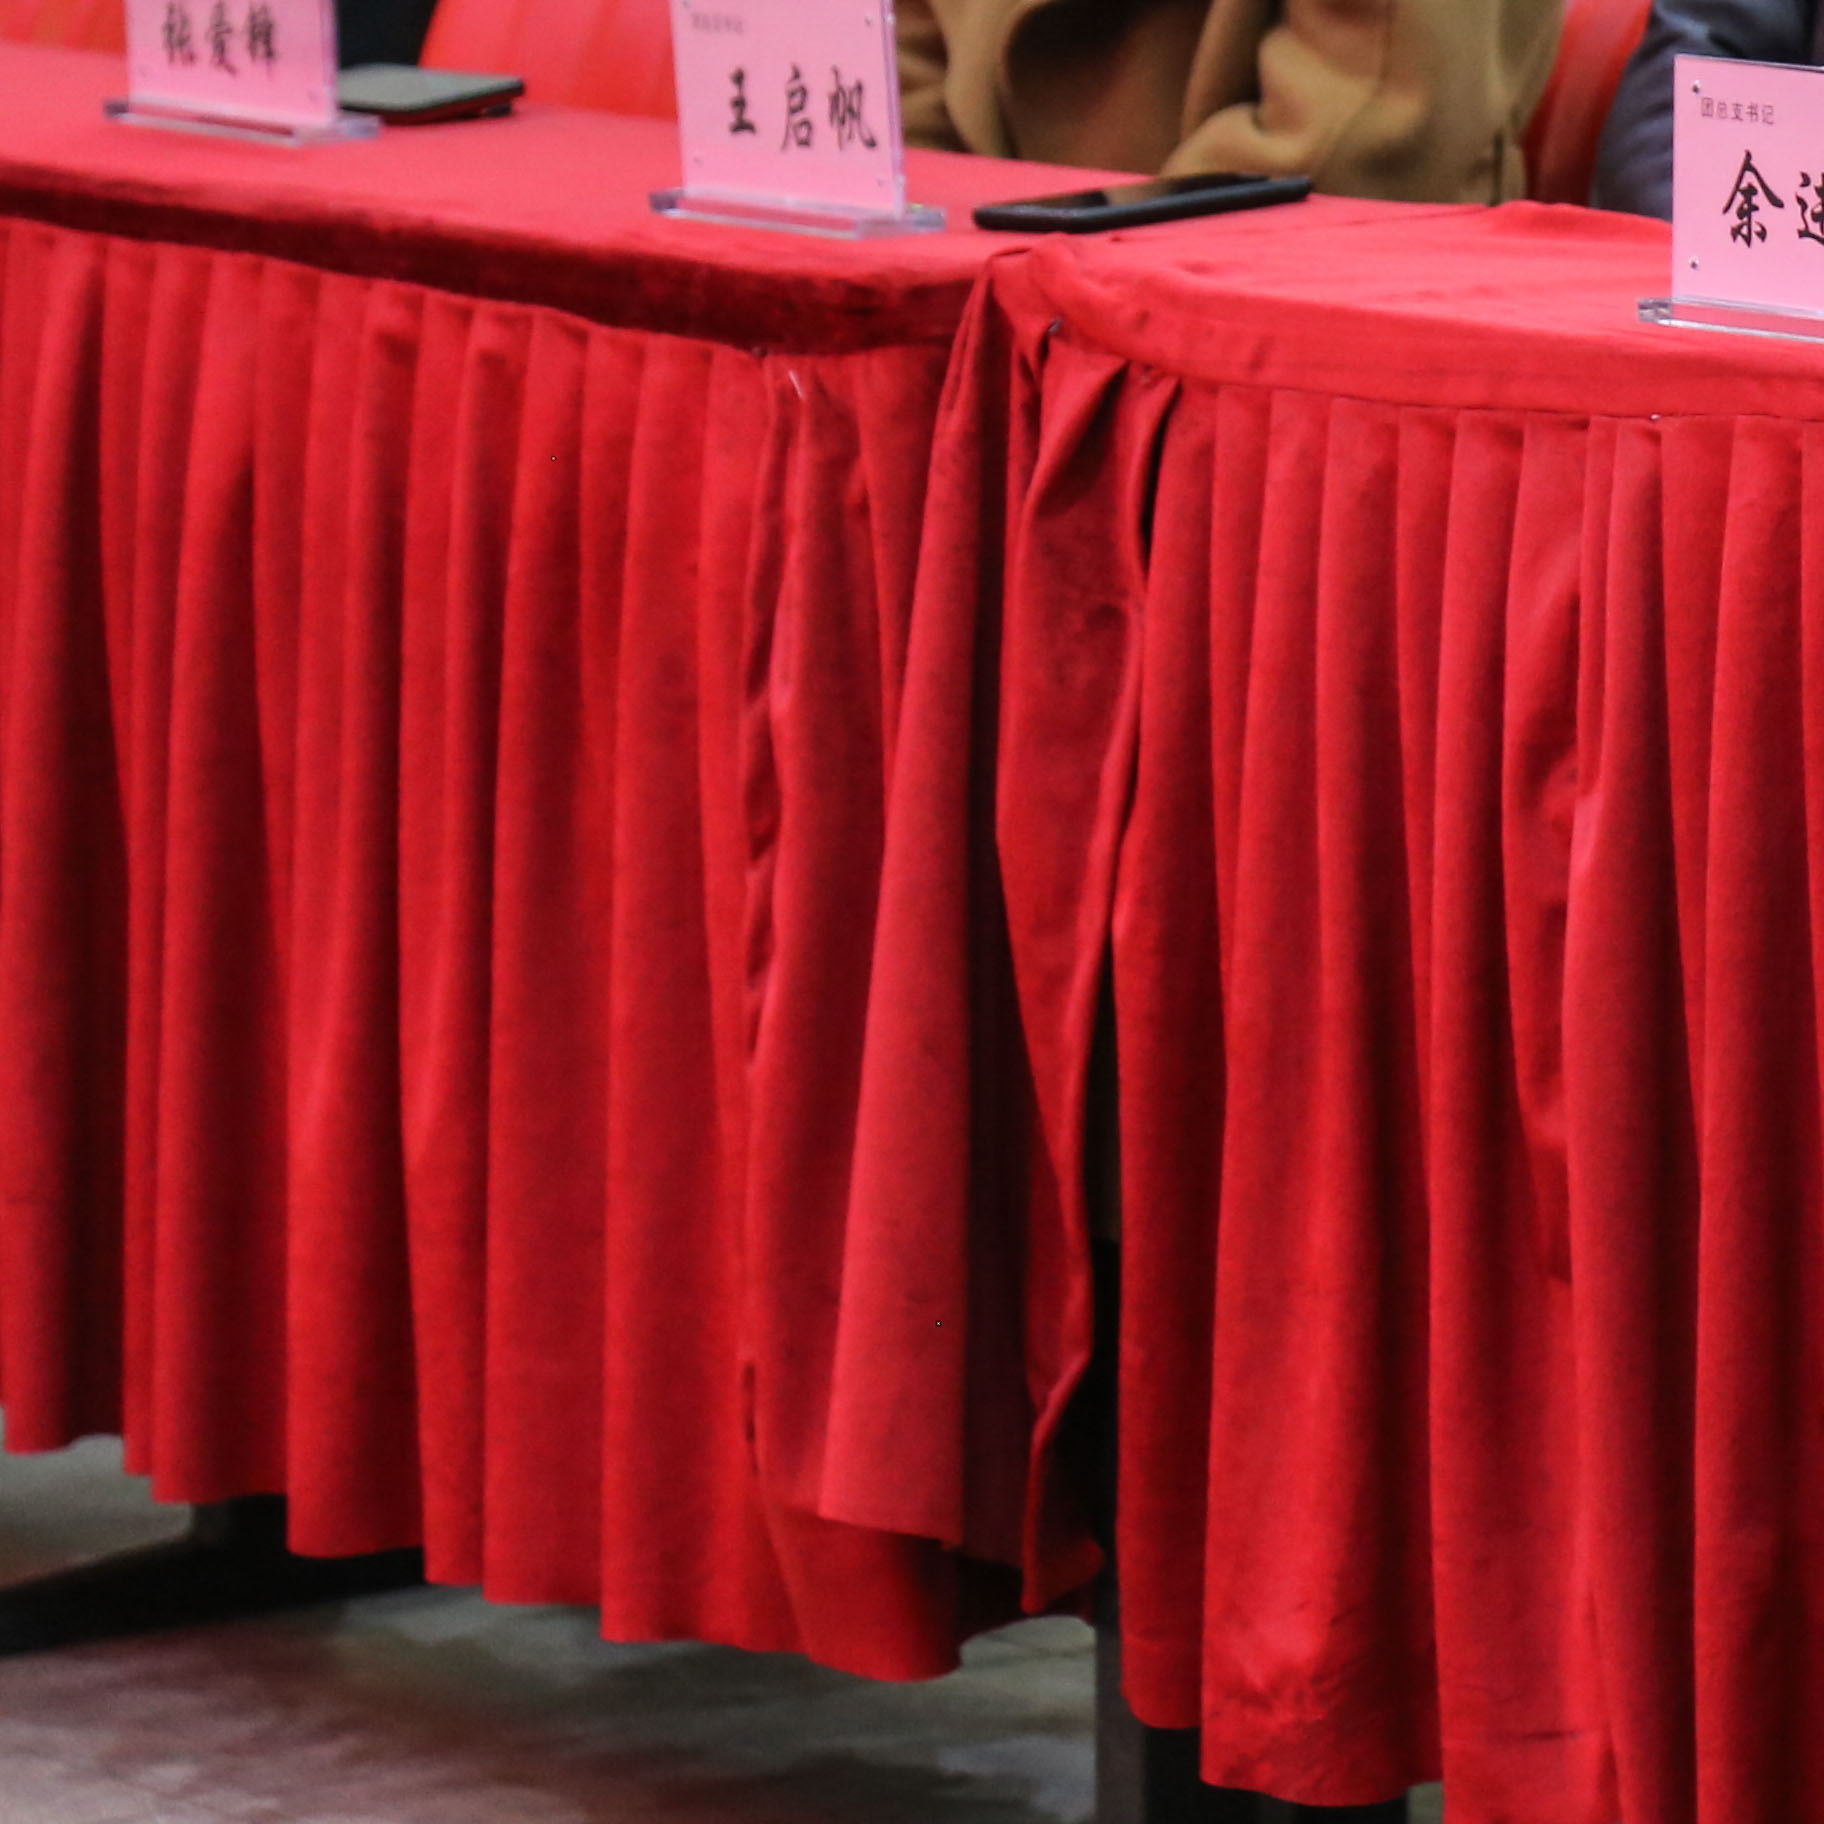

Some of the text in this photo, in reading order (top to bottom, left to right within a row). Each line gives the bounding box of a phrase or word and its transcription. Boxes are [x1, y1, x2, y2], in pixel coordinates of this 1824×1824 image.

[727, 62, 878, 153] 王启帆
[1699, 96, 1776, 126] 团总支书记
